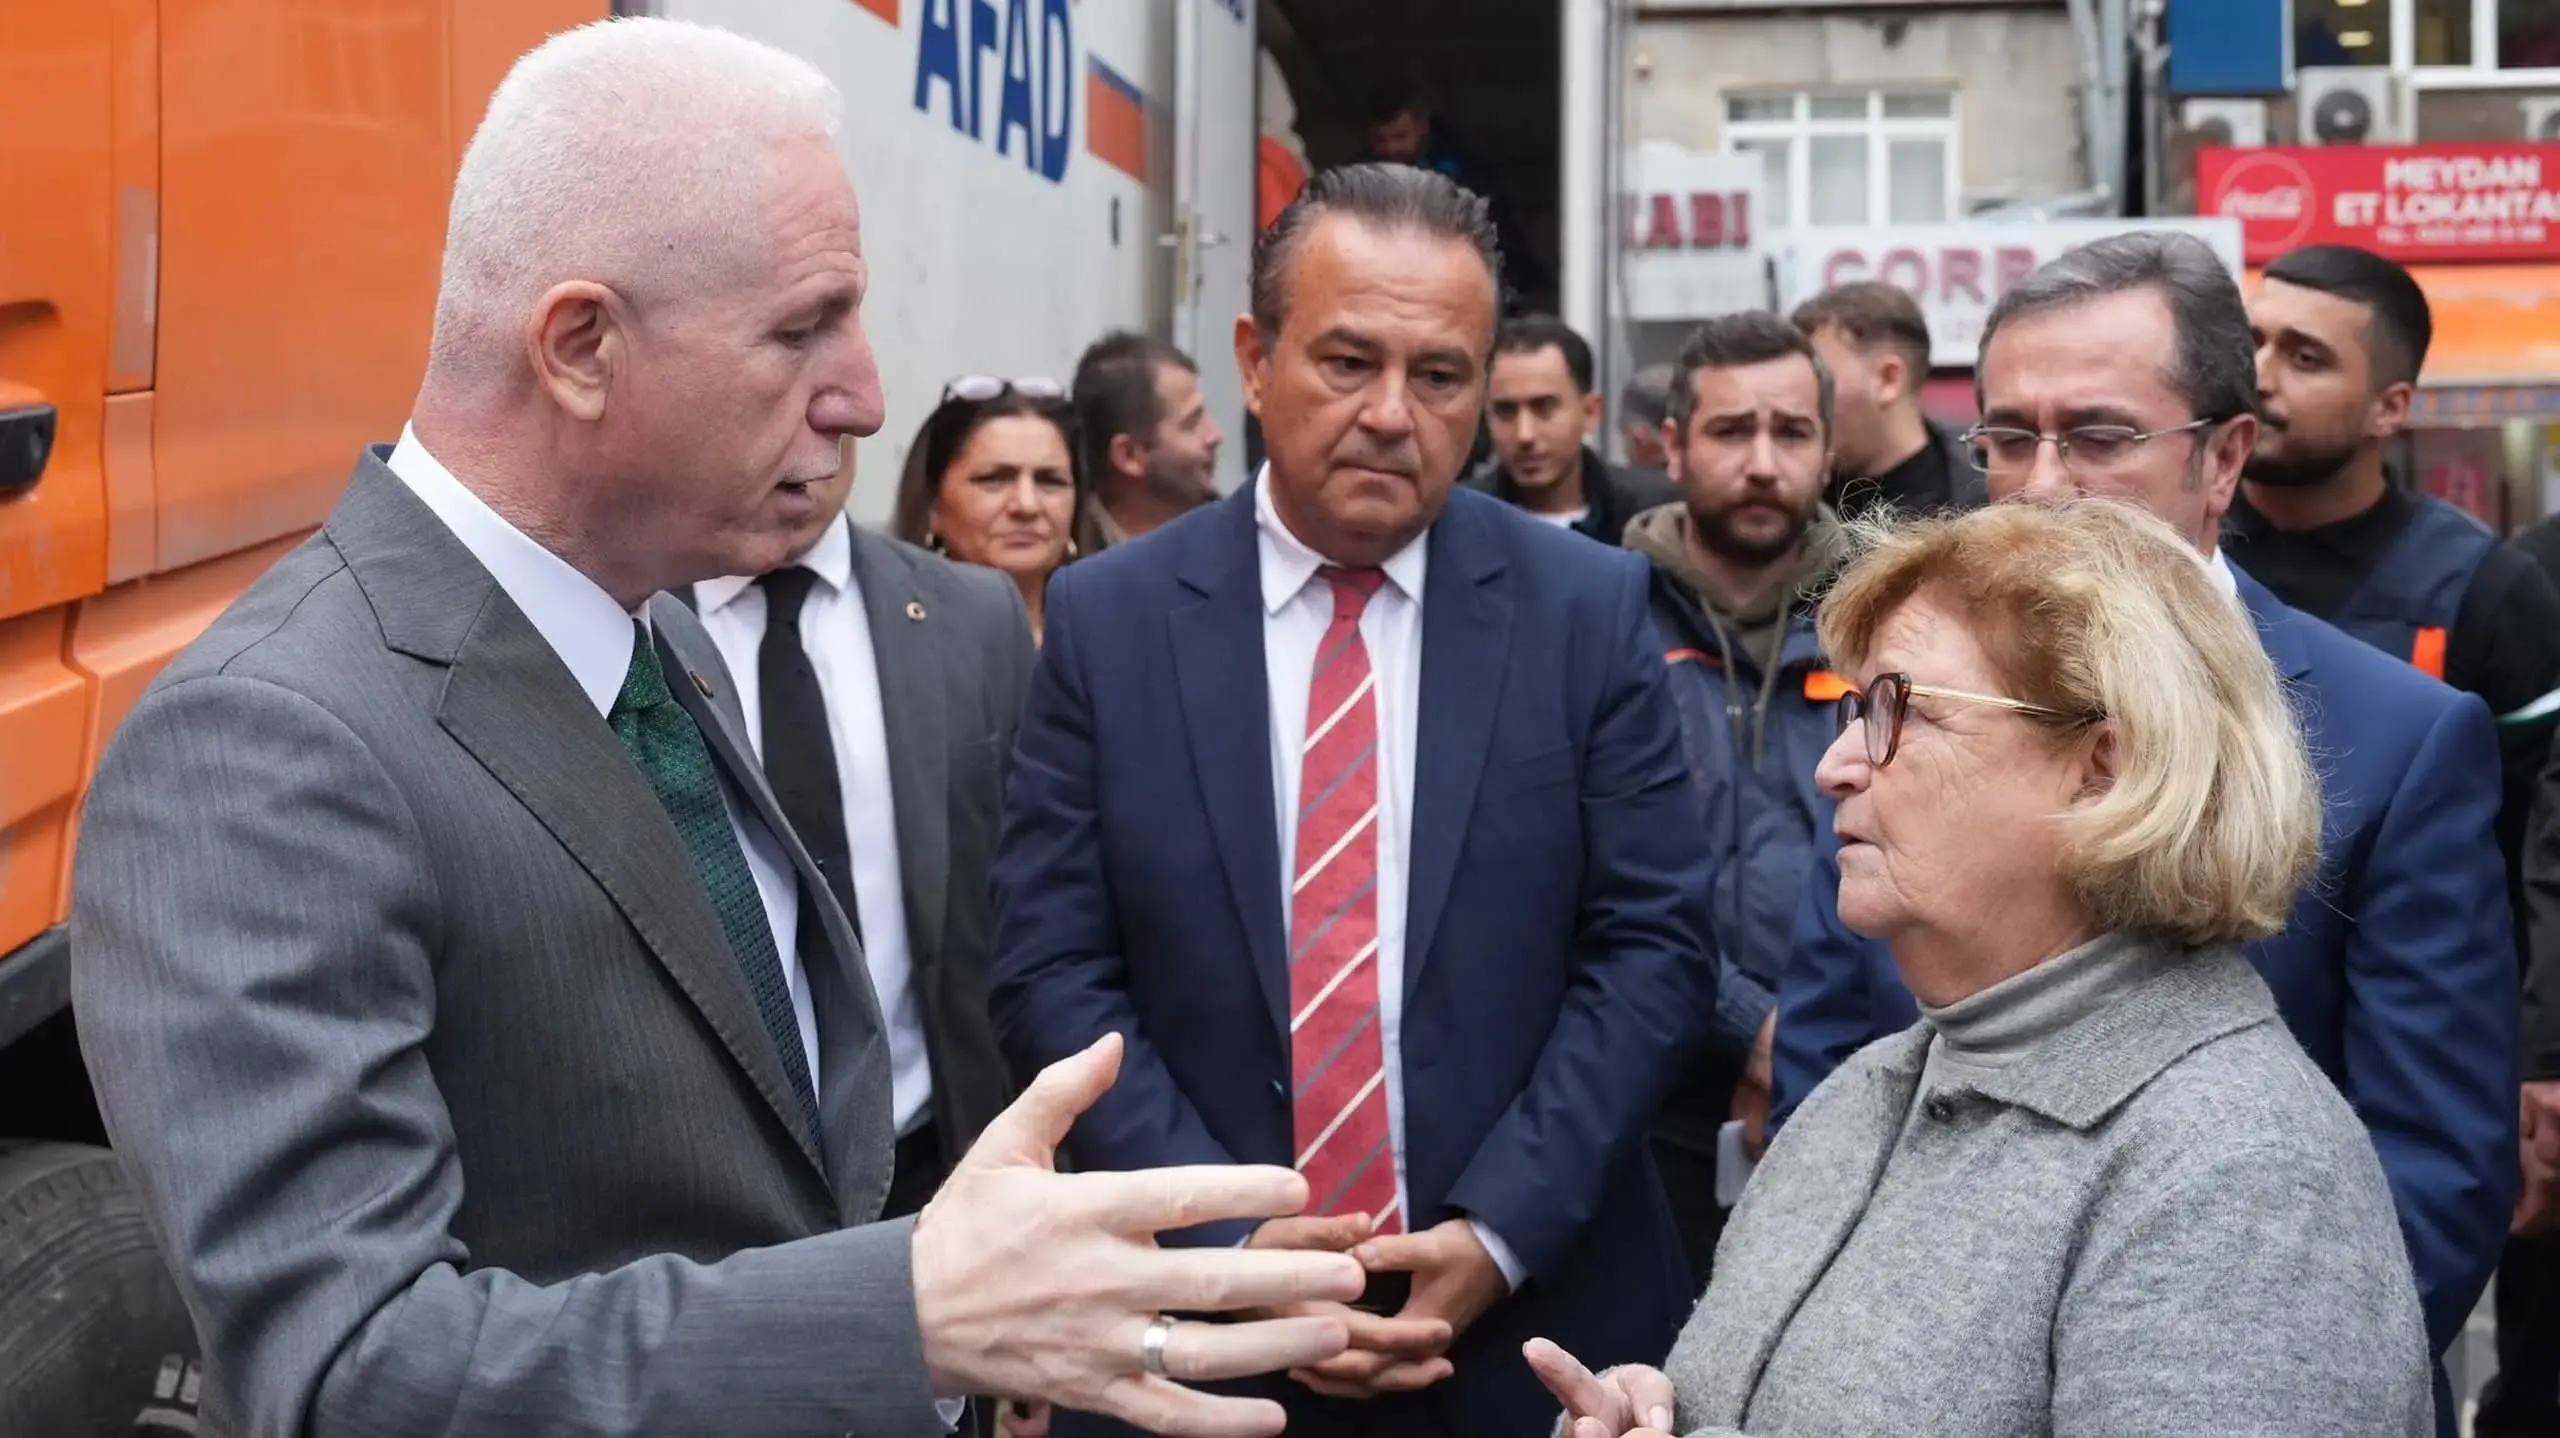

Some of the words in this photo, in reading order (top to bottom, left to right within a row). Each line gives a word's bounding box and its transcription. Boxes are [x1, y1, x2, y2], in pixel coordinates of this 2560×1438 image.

[914, 0, 1073, 184] AFAD
[2384, 155, 2541, 188] MEYDAN
[2333, 192, 2379, 226] ET
[2385, 189, 2560, 224] LOKANTA
